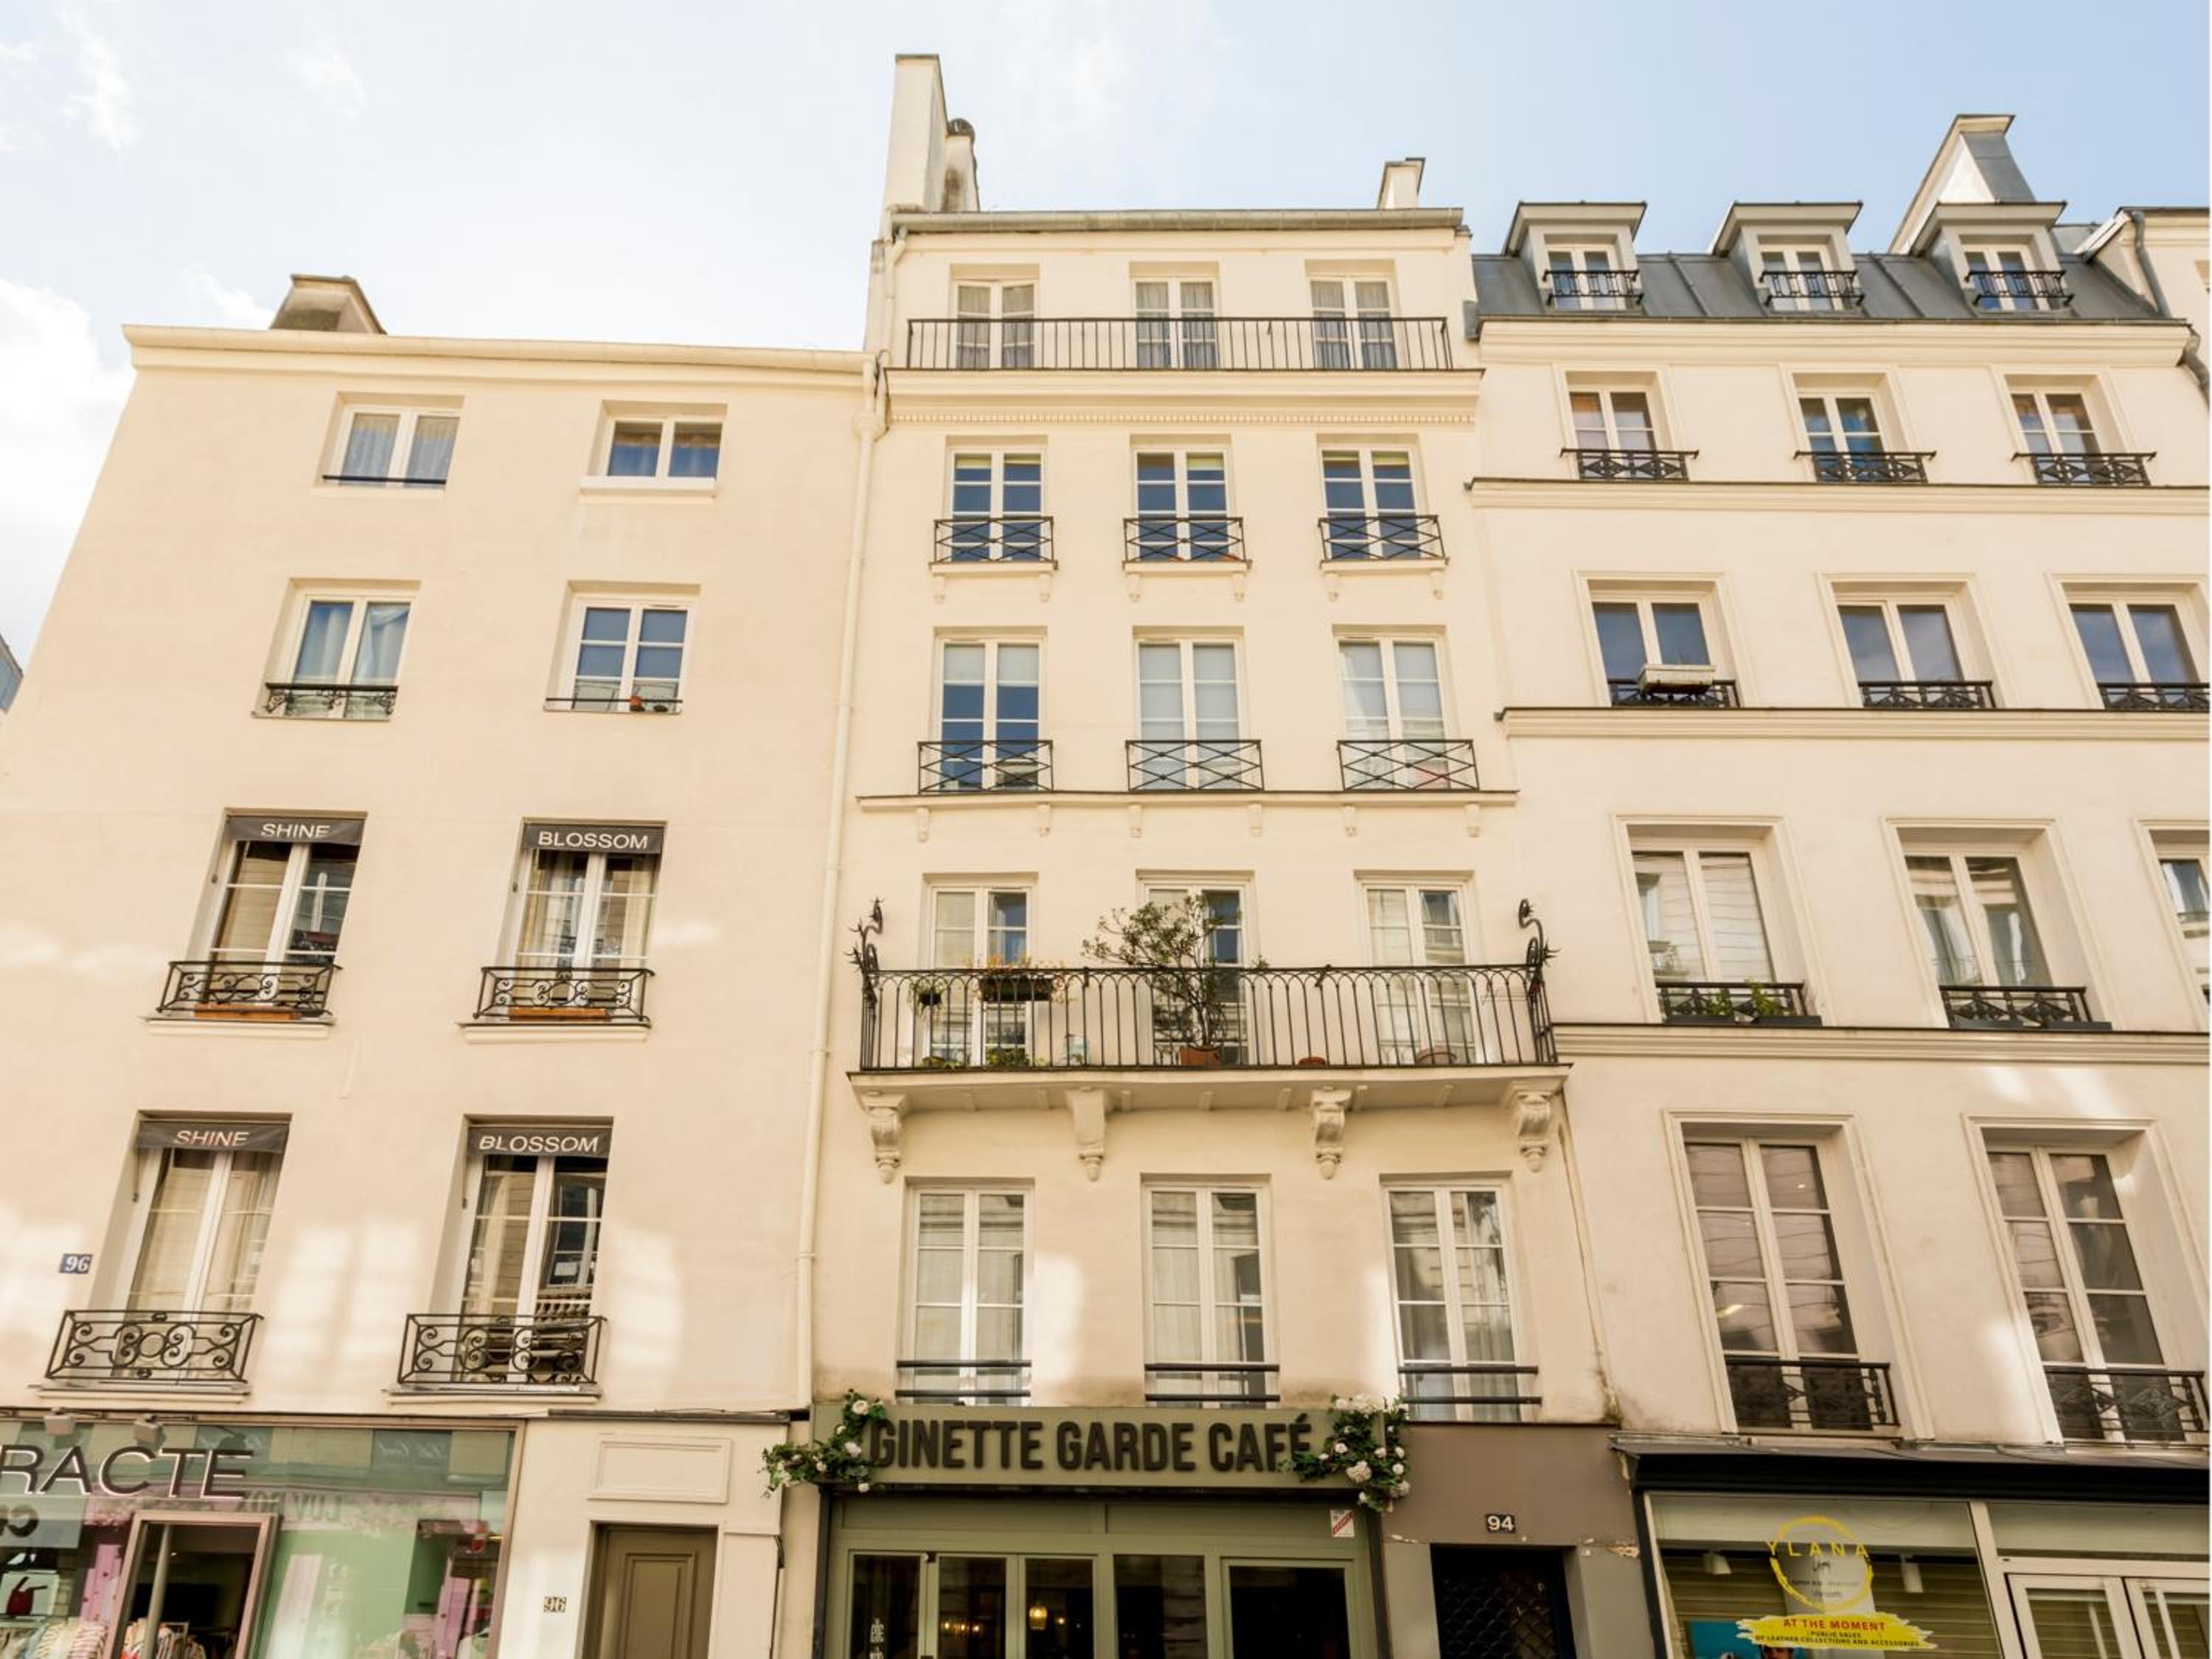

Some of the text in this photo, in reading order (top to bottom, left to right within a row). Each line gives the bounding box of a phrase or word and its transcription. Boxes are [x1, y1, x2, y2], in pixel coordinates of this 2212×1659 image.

[260, 822, 330, 838] SHINE
[538, 831, 649, 849] BLOSSOM
[173, 1130, 251, 1147] SHINE
[479, 1135, 599, 1152] BLOSSOM
[64, 1256, 91, 1272] 96
[869, 1412, 1312, 1472] GINETTE GARDE CAFÉ
[0, 1444, 254, 1499] RACTE
[1486, 1514, 1514, 1531] 94
[1764, 1539, 1869, 1557] YLANA
[543, 1596, 566, 1613] 96
[1783, 1618, 1886, 1631] AT THE MOMENT
